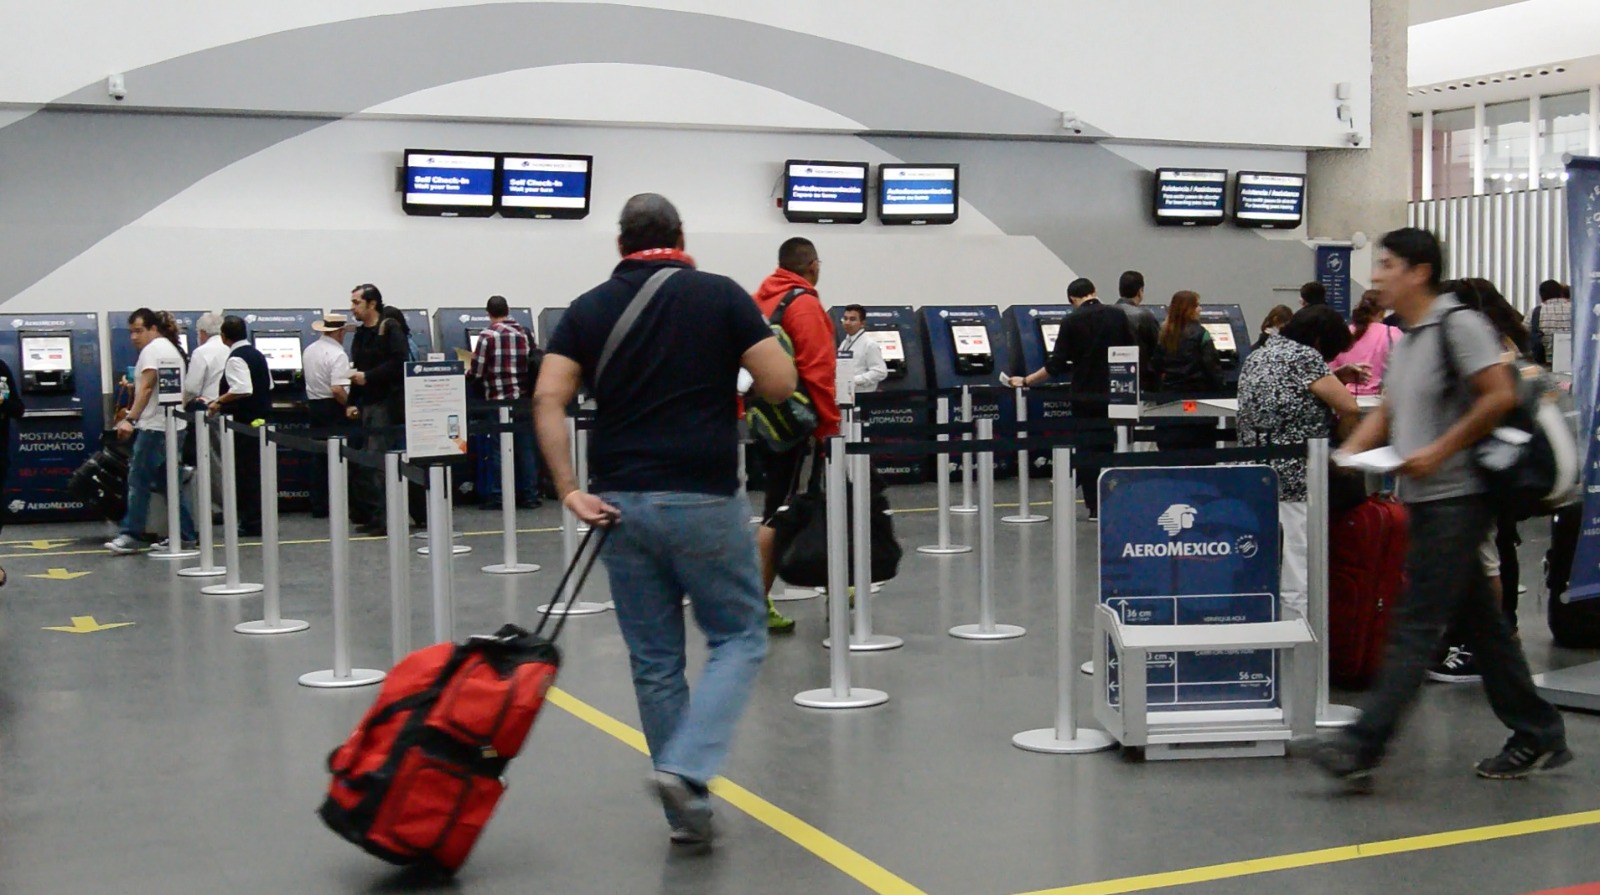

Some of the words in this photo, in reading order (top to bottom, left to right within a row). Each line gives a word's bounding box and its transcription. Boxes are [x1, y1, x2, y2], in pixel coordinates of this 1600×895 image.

[869, 415, 914, 424] UTOMÁTICO
[19, 432, 84, 441] MOSTRADOR
[19, 442, 85, 452] AUTOMÁTICO
[27, 501, 84, 510] AEROMEXICO
[1122, 541, 1230, 558] AEROMEXICO
[1127, 608, 1137, 618] 36
[1139, 610, 1152, 618] cm
[1239, 671, 1249, 680] 56
[1251, 672, 1264, 680] cm
